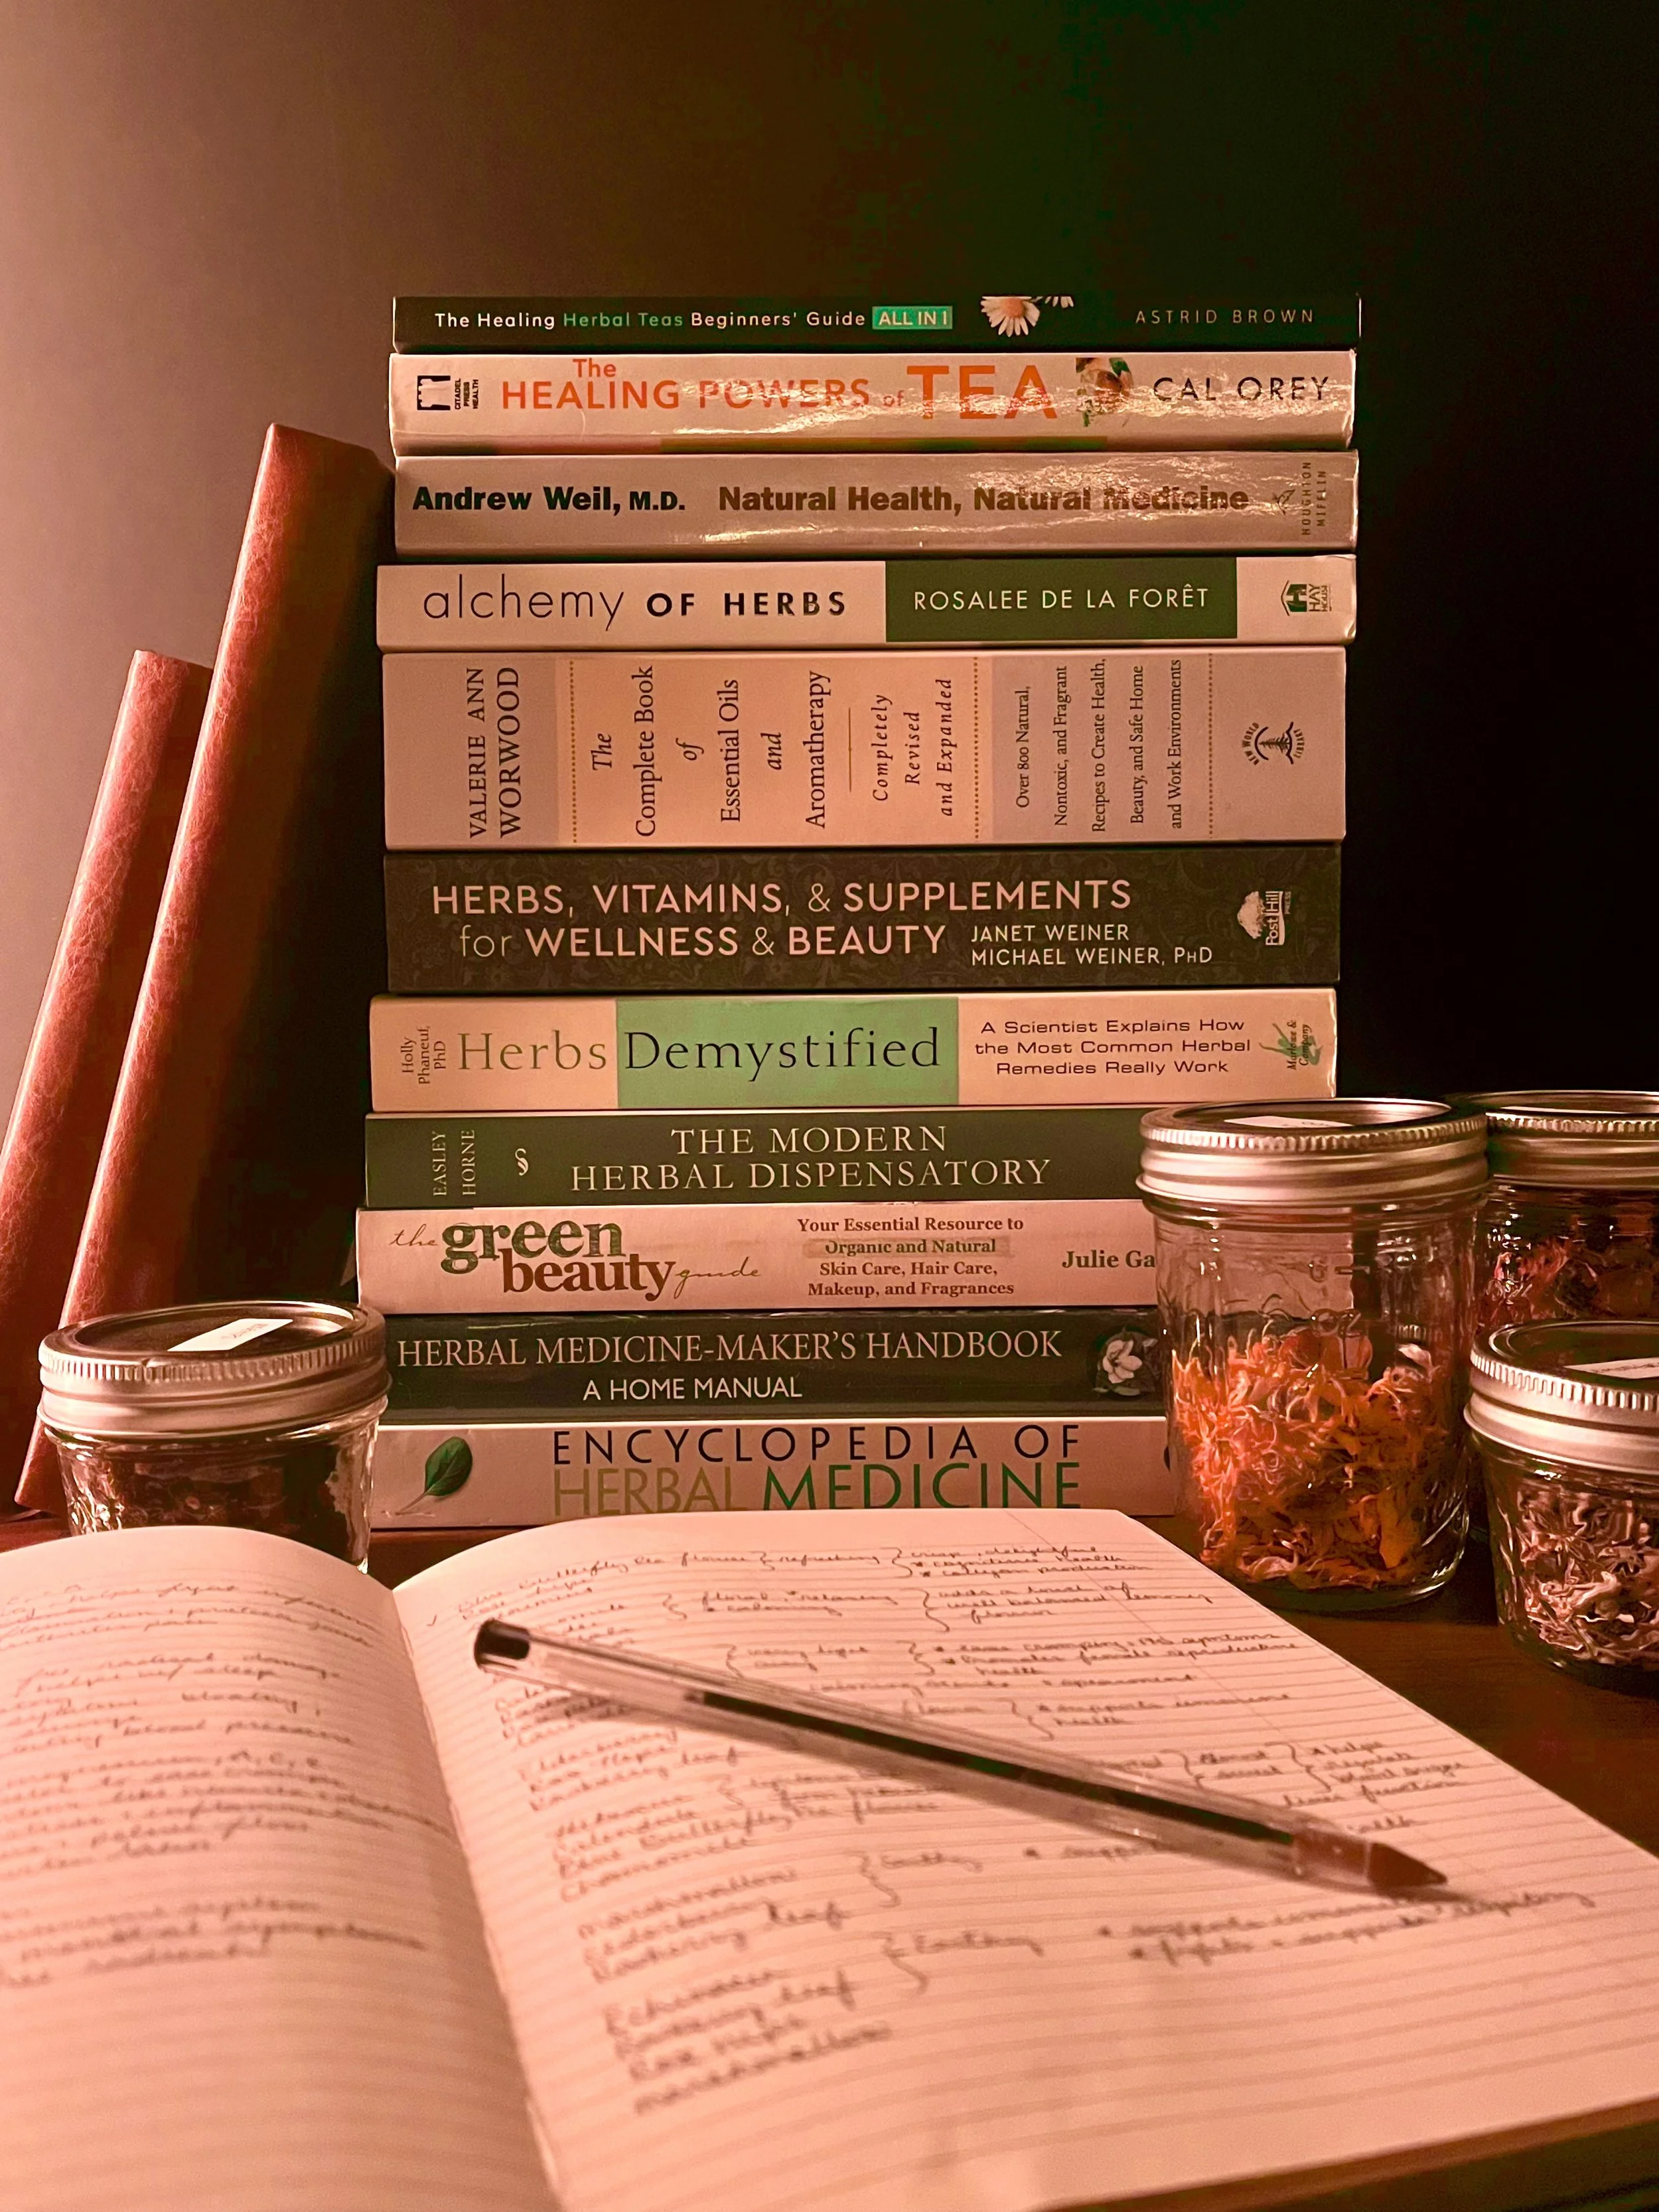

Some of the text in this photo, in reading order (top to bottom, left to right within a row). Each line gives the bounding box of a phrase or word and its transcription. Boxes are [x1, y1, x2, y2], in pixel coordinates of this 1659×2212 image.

[435, 313, 470, 328] The
[477, 311, 555, 330] Healing
[563, 312, 630, 327] Herbal
[638, 312, 683, 327] Teas
[690, 310, 796, 331] Beginners'
[806, 310, 865, 326] Guide
[879, 311, 913, 326] ALL
[918, 311, 936, 325] IN
[1135, 308, 1315, 324] ASTRID BROWN
[573, 357, 616, 378] The
[502, 364, 1058, 419] HEALING POWERS of TEA
[1153, 376, 1330, 402] CAL OREY
[412, 486, 685, 516] Andrew Weil, M.D.
[719, 485, 1249, 516] Natural Health, Natural Medicine
[1301, 463, 1311, 536] HOUGHTON
[1317, 471, 1326, 526] MIFFLIN
[423, 573, 846, 631] alchemy OF HERBS
[914, 583, 1208, 611] ROSALEE DE LA FORÊT
[1309, 583, 1321, 612] HAY
[467, 667, 486, 839] VALERIE ANN
[496, 666, 521, 838] WORWOOD
[591, 733, 613, 771] The
[630, 665, 663, 838] Complete Book
[675, 737, 705, 763] of
[717, 679, 741, 823] Essential Oils
[761, 731, 783, 771] and
[802, 670, 831, 830] Aromatherapy
[871, 694, 893, 802] Completely
[904, 710, 920, 786] Revised
[935, 678, 958, 818] and Expanded
[1014, 685, 1031, 808] Over 800 Natural,
[1052, 666, 1071, 826] Nontoxic, and Fragrant
[1090, 658, 1110, 832] Recipes to Create Health,
[1129, 664, 1147, 824] Beauty, and Safe Home
[1167, 660, 1182, 829] and Work Environments
[1244, 751, 1260, 766] NEW
[433, 879, 1131, 918] HERBS, VITAMINS, & SUPPLEMENTS
[971, 923, 1129, 943] JANET WEINER
[1265, 891, 1279, 946] Post Hill
[459, 924, 946, 958] for WELLNESS & BEAUTY
[971, 947, 1067, 966] MICHAEL
[1075, 947, 1165, 968] WEINER,
[975, 1039, 1251, 1054] the Most Common Herbal
[981, 1019, 1245, 1037] A Scientist Explains How
[400, 1037, 417, 1072] Holly
[433, 1041, 446, 1069] PhD
[457, 1027, 940, 1082] Herbs Demystified
[997, 1061, 1229, 1078] Remedies Really Work
[671, 1126, 947, 1155] THE MODERN
[433, 1130, 447, 1197] EASLEY
[461, 1129, 476, 1195] HORNE
[571, 1159, 1052, 1192] HERBAL DISPENSATORY
[797, 1217, 1024, 1232] Your Essential Resource to
[389, 1220, 628, 1274] the green
[895, 1238, 927, 1254] and
[931, 1238, 996, 1254] Natural
[1062, 1250, 1119, 1268] Julie
[498, 1248, 761, 1302] beauty guide
[820, 1261, 998, 1279] Skin Care, Hair Care,
[808, 1281, 1015, 1300] Makeup, and Fragrances
[397, 1338, 526, 1367] HERBAL
[867, 1331, 1062, 1359] HANDBOOK
[583, 1376, 803, 1401] A HOME MANUAL
[553, 1424, 1079, 1465] ENCYCLOPEDIA OF
[553, 1461, 1081, 1516] HERBAL MEDICINE
